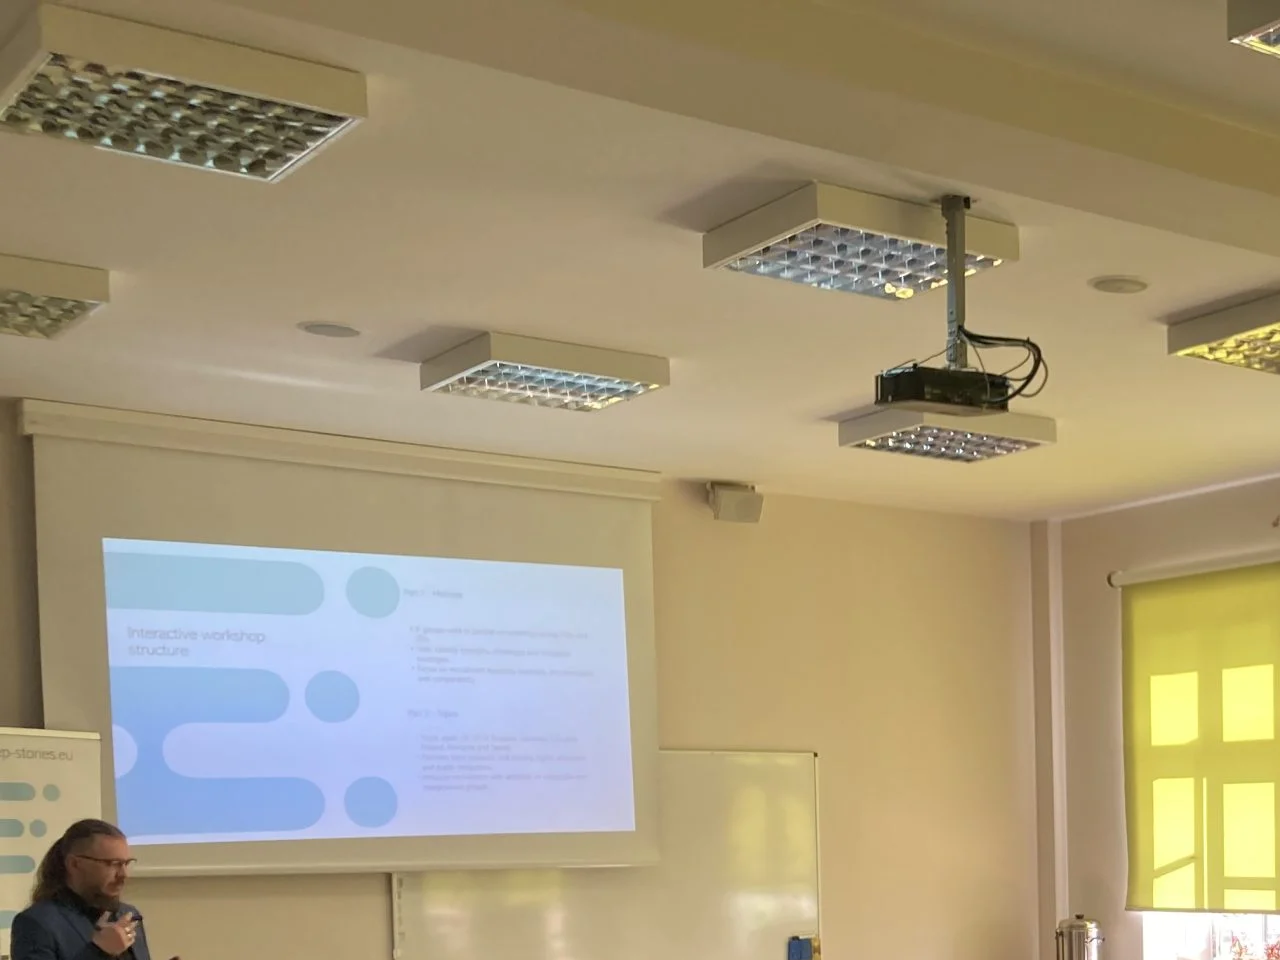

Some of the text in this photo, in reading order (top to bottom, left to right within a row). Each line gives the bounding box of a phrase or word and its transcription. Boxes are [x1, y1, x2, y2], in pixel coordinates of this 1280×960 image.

[127, 627, 265, 644] Interactive workshop
[128, 645, 189, 656] structure
[0, 748, 74, 761] p-stories.eu
